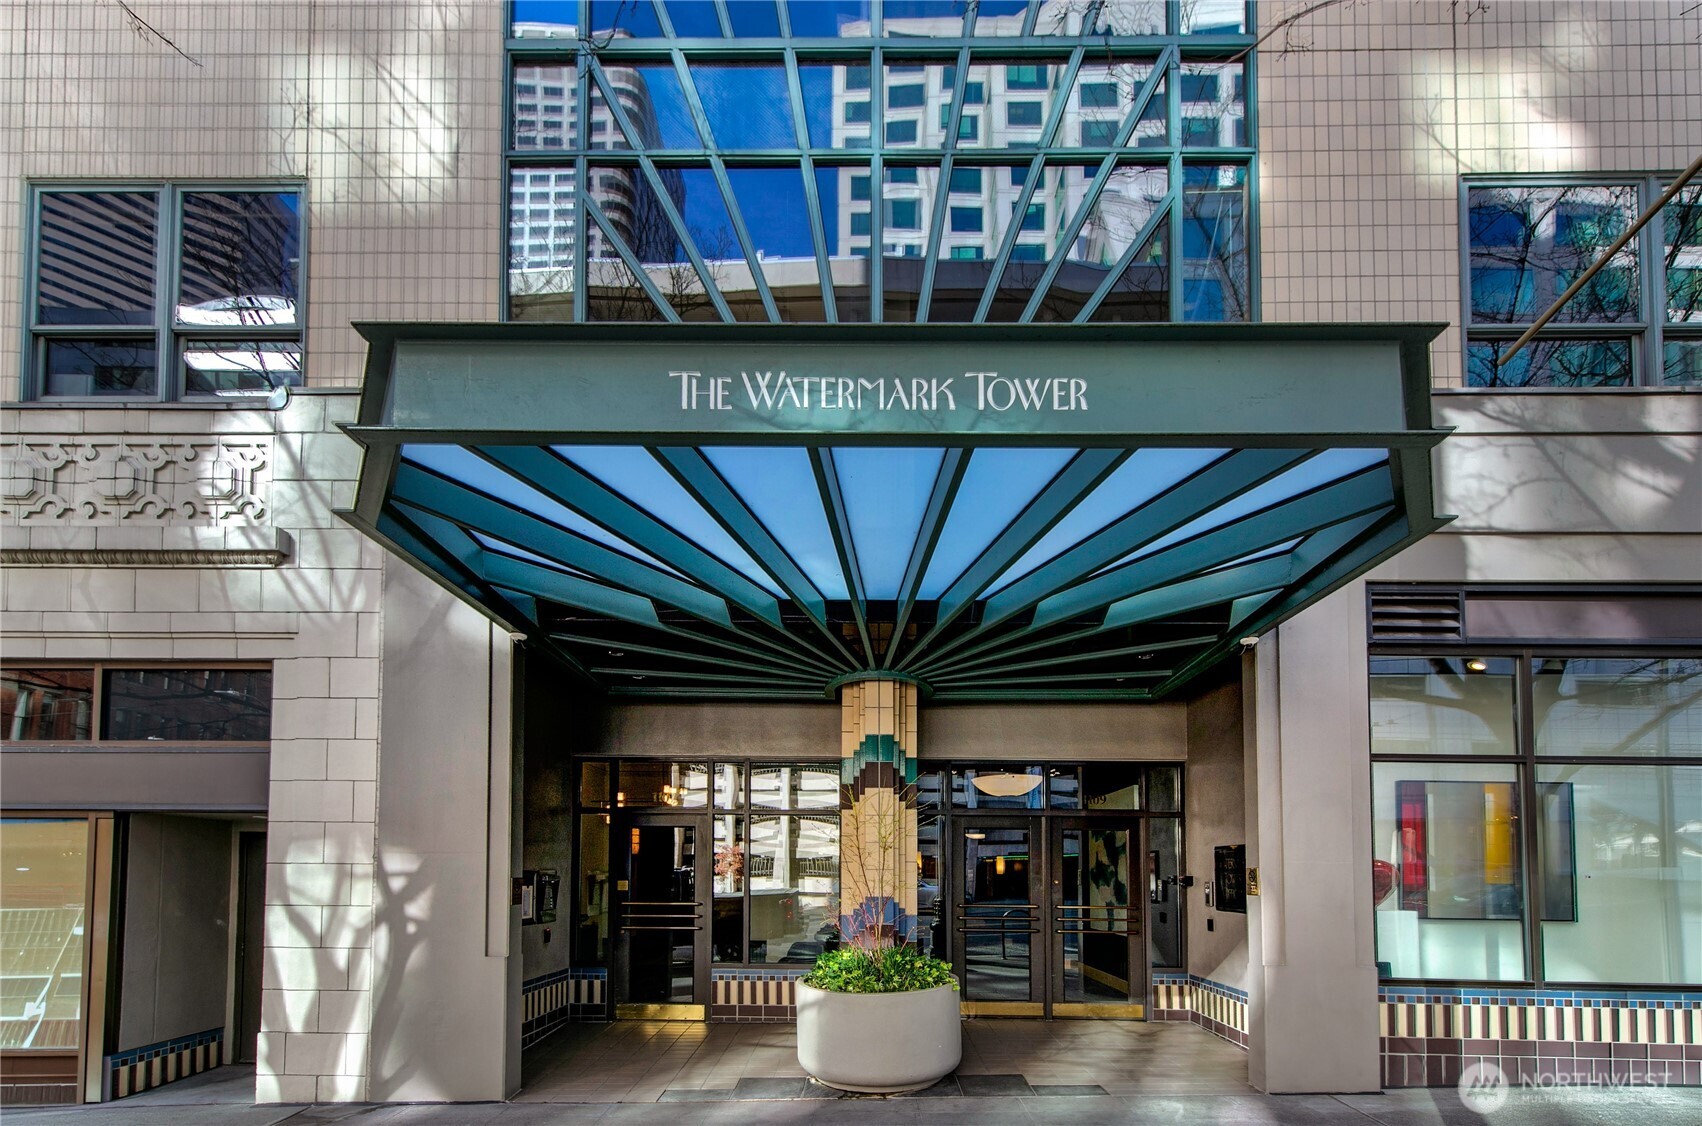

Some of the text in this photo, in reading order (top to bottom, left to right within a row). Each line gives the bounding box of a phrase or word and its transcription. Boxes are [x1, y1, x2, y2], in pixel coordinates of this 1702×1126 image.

[669, 371, 1088, 410] THE WATERMARK TOWER
